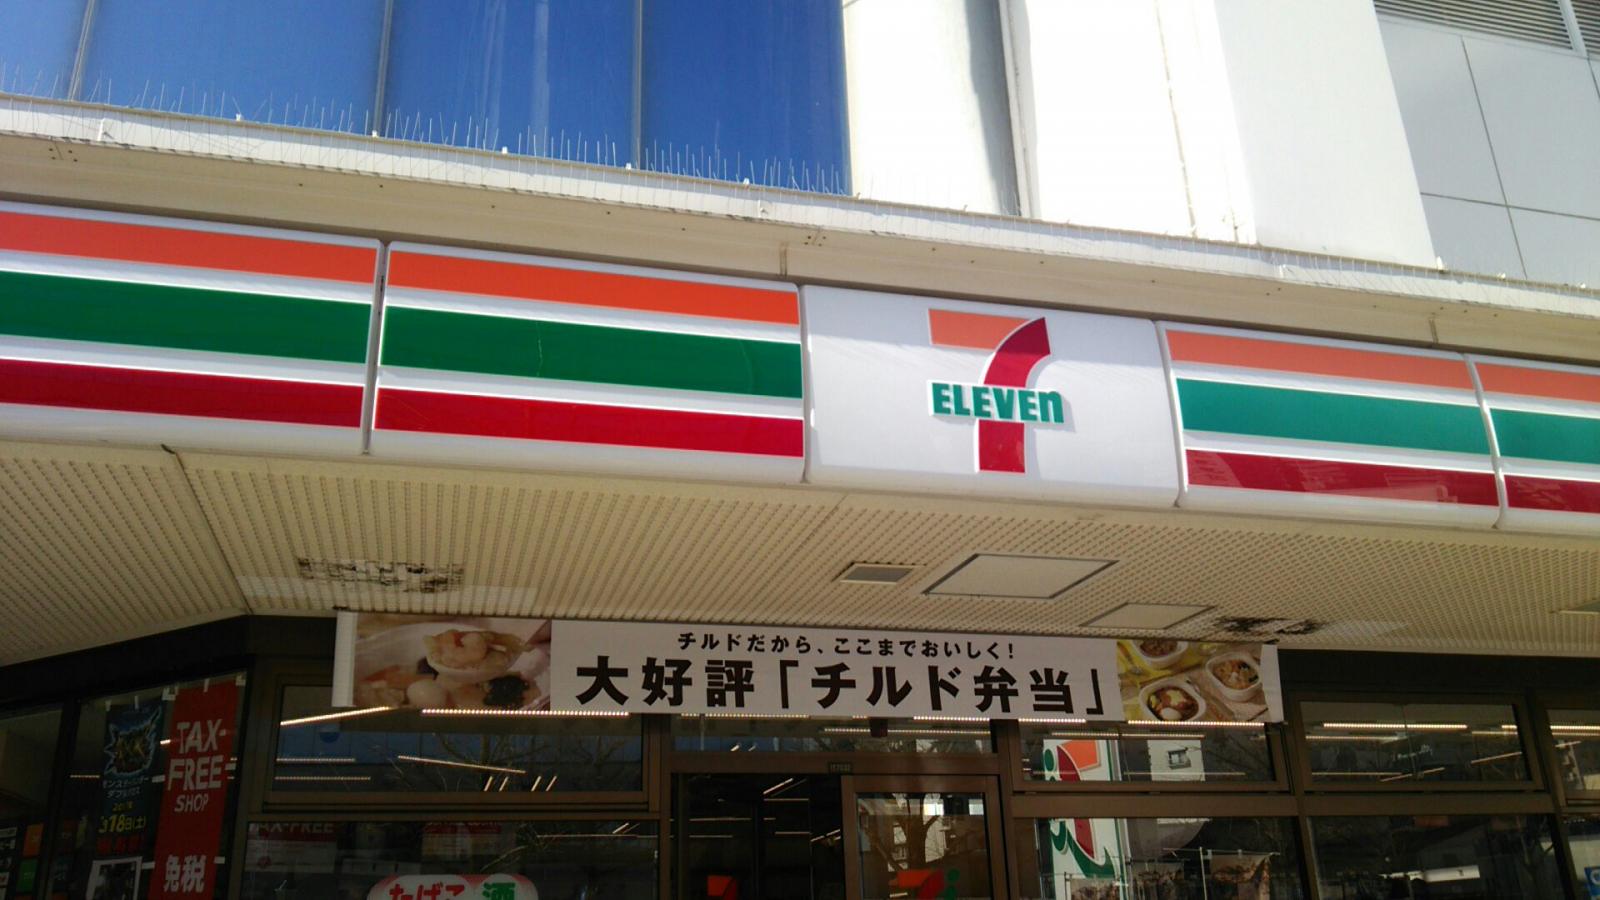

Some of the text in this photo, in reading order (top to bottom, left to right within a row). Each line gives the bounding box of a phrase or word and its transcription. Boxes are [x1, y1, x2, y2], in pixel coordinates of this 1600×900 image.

[928, 309, 1051, 473] 7
[678, 632, 1014, 659] チルドだから、ここまでおいしく!
[576, 655, 1104, 715] 大好評「チルド弁当」
[177, 719, 222, 754] TAX
[167, 755, 224, 792] FREE
[174, 793, 209, 813] SHOP
[163, 854, 208, 893] 免税
